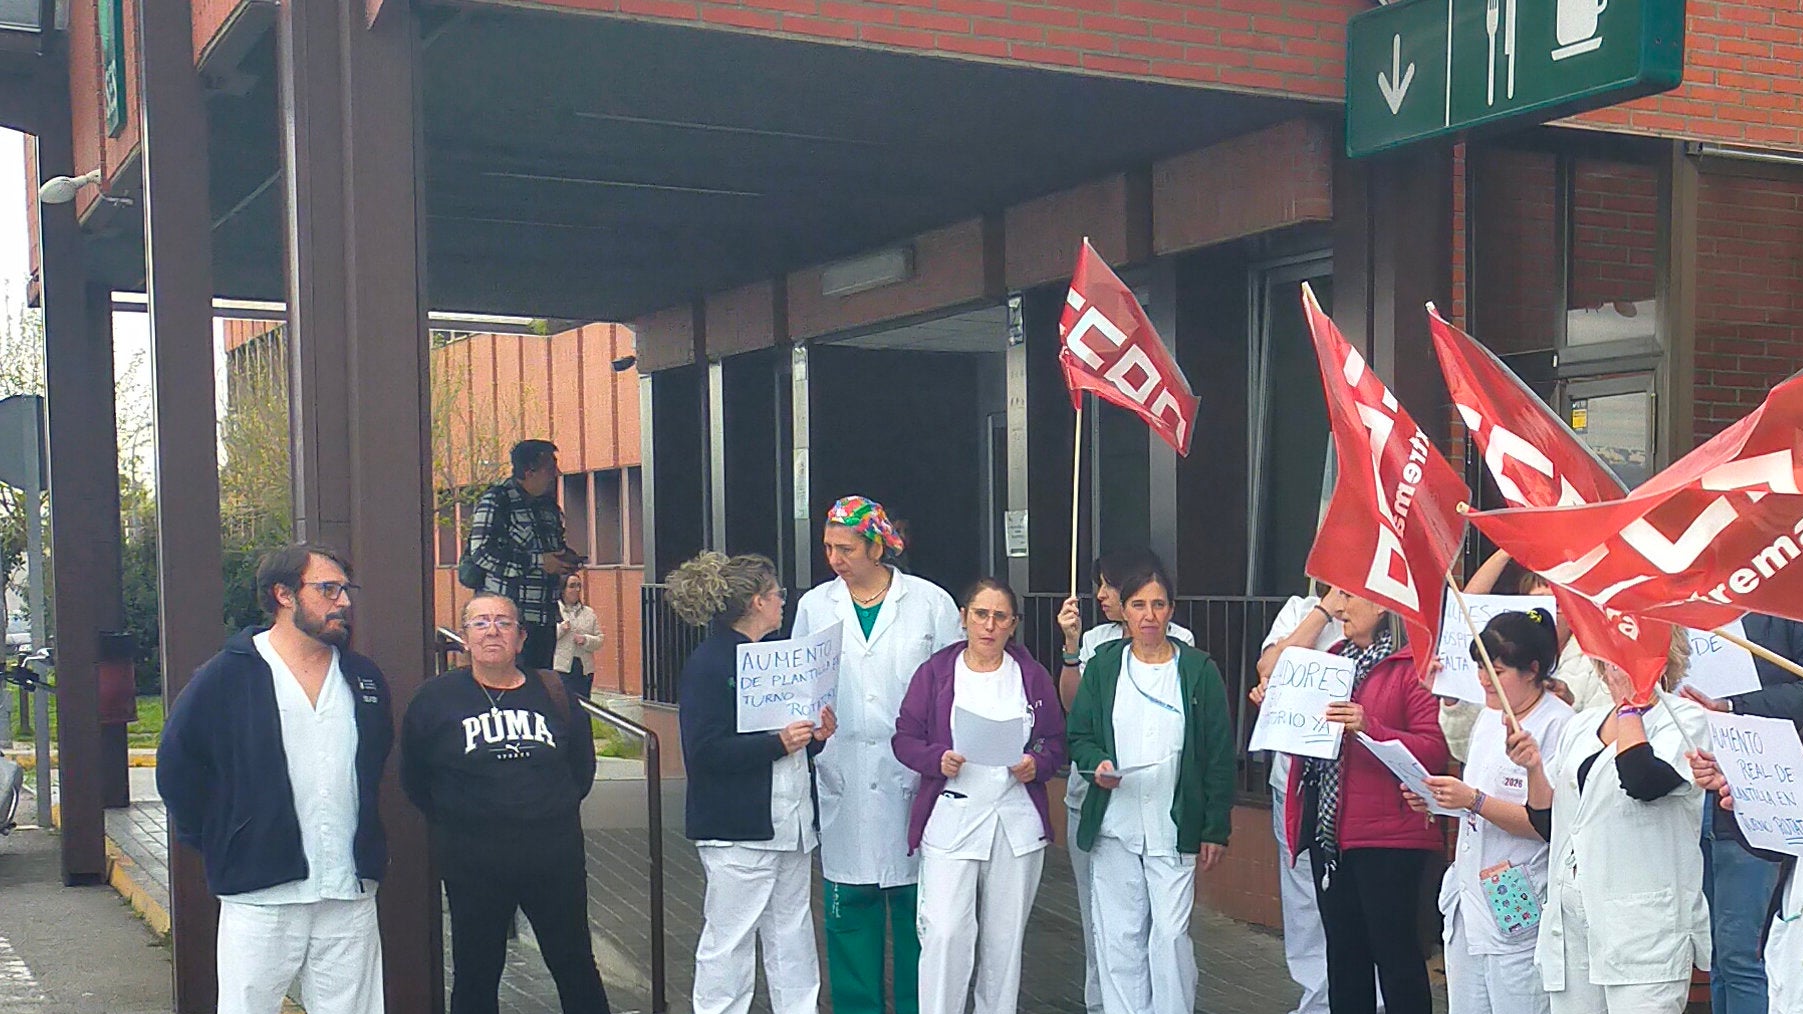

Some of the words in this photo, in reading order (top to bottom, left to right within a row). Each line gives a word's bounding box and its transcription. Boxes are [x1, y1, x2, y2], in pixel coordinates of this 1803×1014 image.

[743, 640, 832, 671] AUMENTO
[1691, 634, 1722, 656] DE
[741, 676, 762, 690] DE
[743, 691, 794, 707] TURNO
[462, 708, 556, 754] PUMA
[1312, 715, 1330, 734] YA
[1737, 759, 1772, 781] REAL
[1774, 763, 1794, 783] DE
